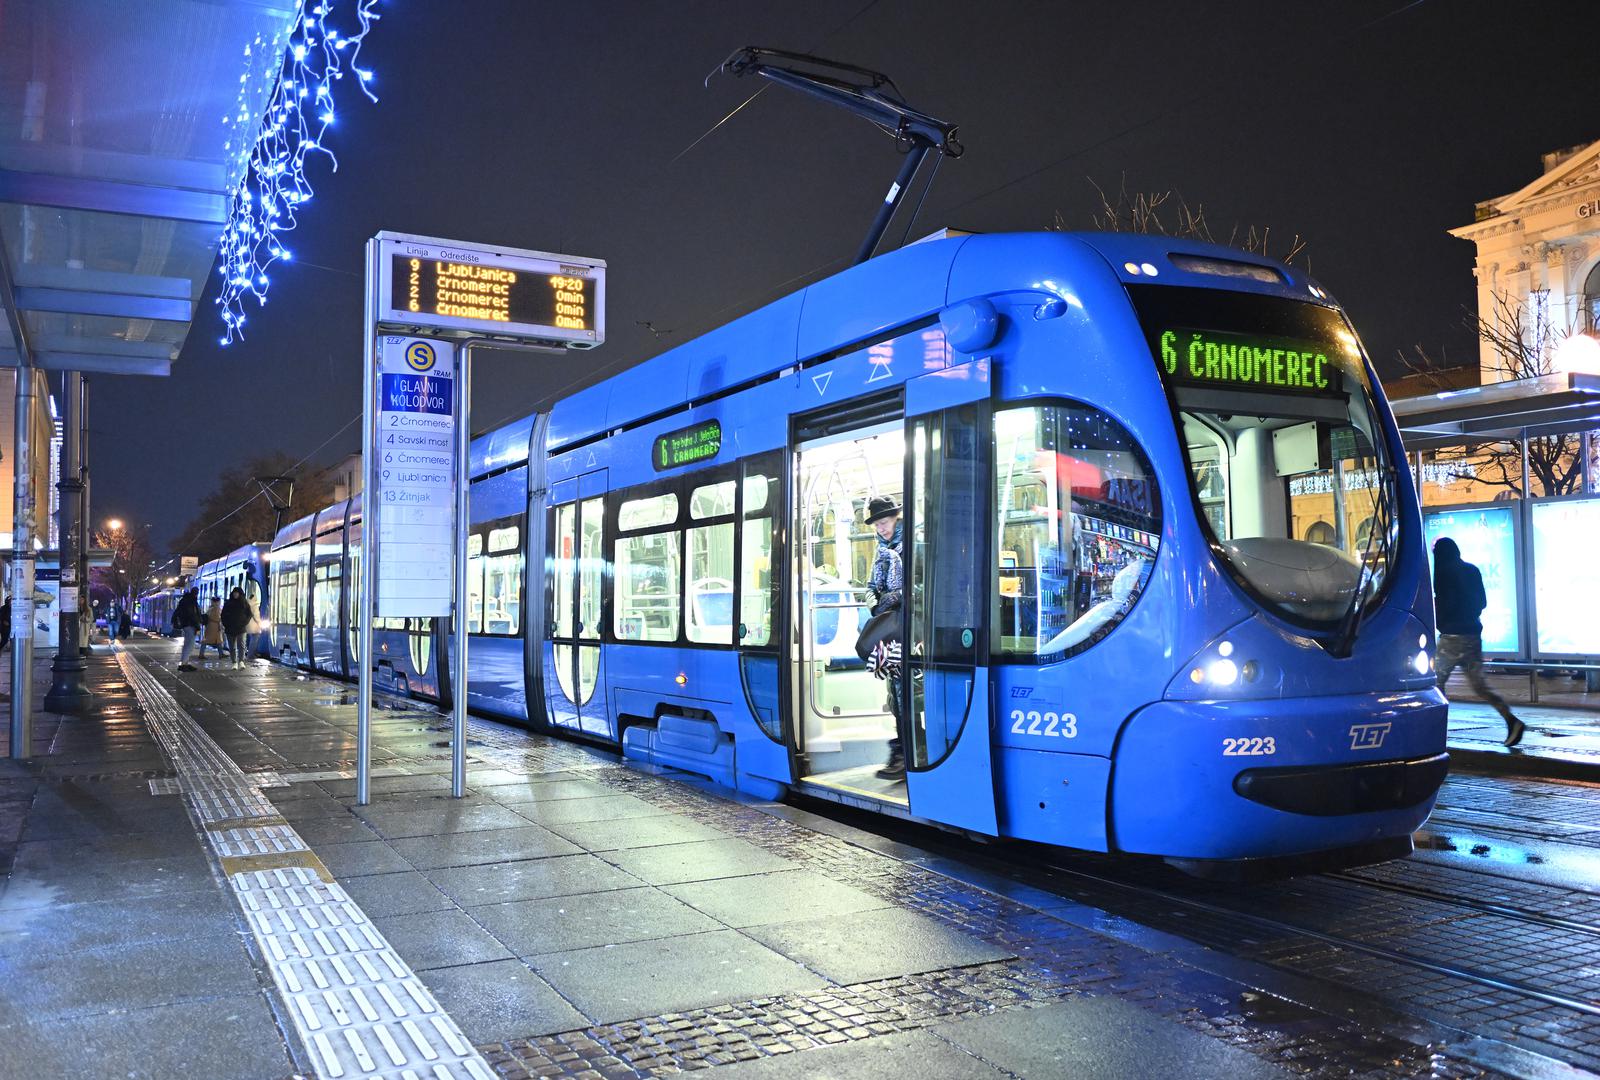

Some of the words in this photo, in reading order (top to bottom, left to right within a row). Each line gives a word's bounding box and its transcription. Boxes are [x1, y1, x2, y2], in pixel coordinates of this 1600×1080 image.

[406, 246, 429, 256] Linija
[440, 250, 479, 262] Odredište
[410, 259, 420, 271] 9
[550, 277, 583, 291] 19:20
[410, 273, 419, 284] 2
[556, 290, 584, 304] 0min
[410, 286, 419, 298] 2
[556, 303, 584, 317] 0min
[409, 299, 420, 312] 6
[556, 315, 584, 329] 0min
[1161, 331, 1176, 374] 6
[1189, 334, 1328, 388] ČRNOMEREC
[433, 370, 451, 378] TRAM
[400, 380, 438, 394] GLAVNI
[391, 394, 444, 409] KOLODVOR
[391, 415, 398, 427] 2
[400, 416, 451, 428] Črnomerec
[386, 434, 394, 445] 4
[398, 435, 426, 446] Savski
[428, 438, 448, 447] most
[384, 452, 393, 463] 6
[397, 452, 450, 465] Črnomerec
[661, 439, 668, 466] 6
[382, 470, 391, 480] 9
[383, 490, 396, 502] 13
[398, 490, 431, 504] Žitnjak
[1011, 686, 1034, 698] ZET
[1010, 709, 1077, 739] 2223
[1222, 736, 1276, 756] 2223
[1349, 722, 1391, 750] ZET
